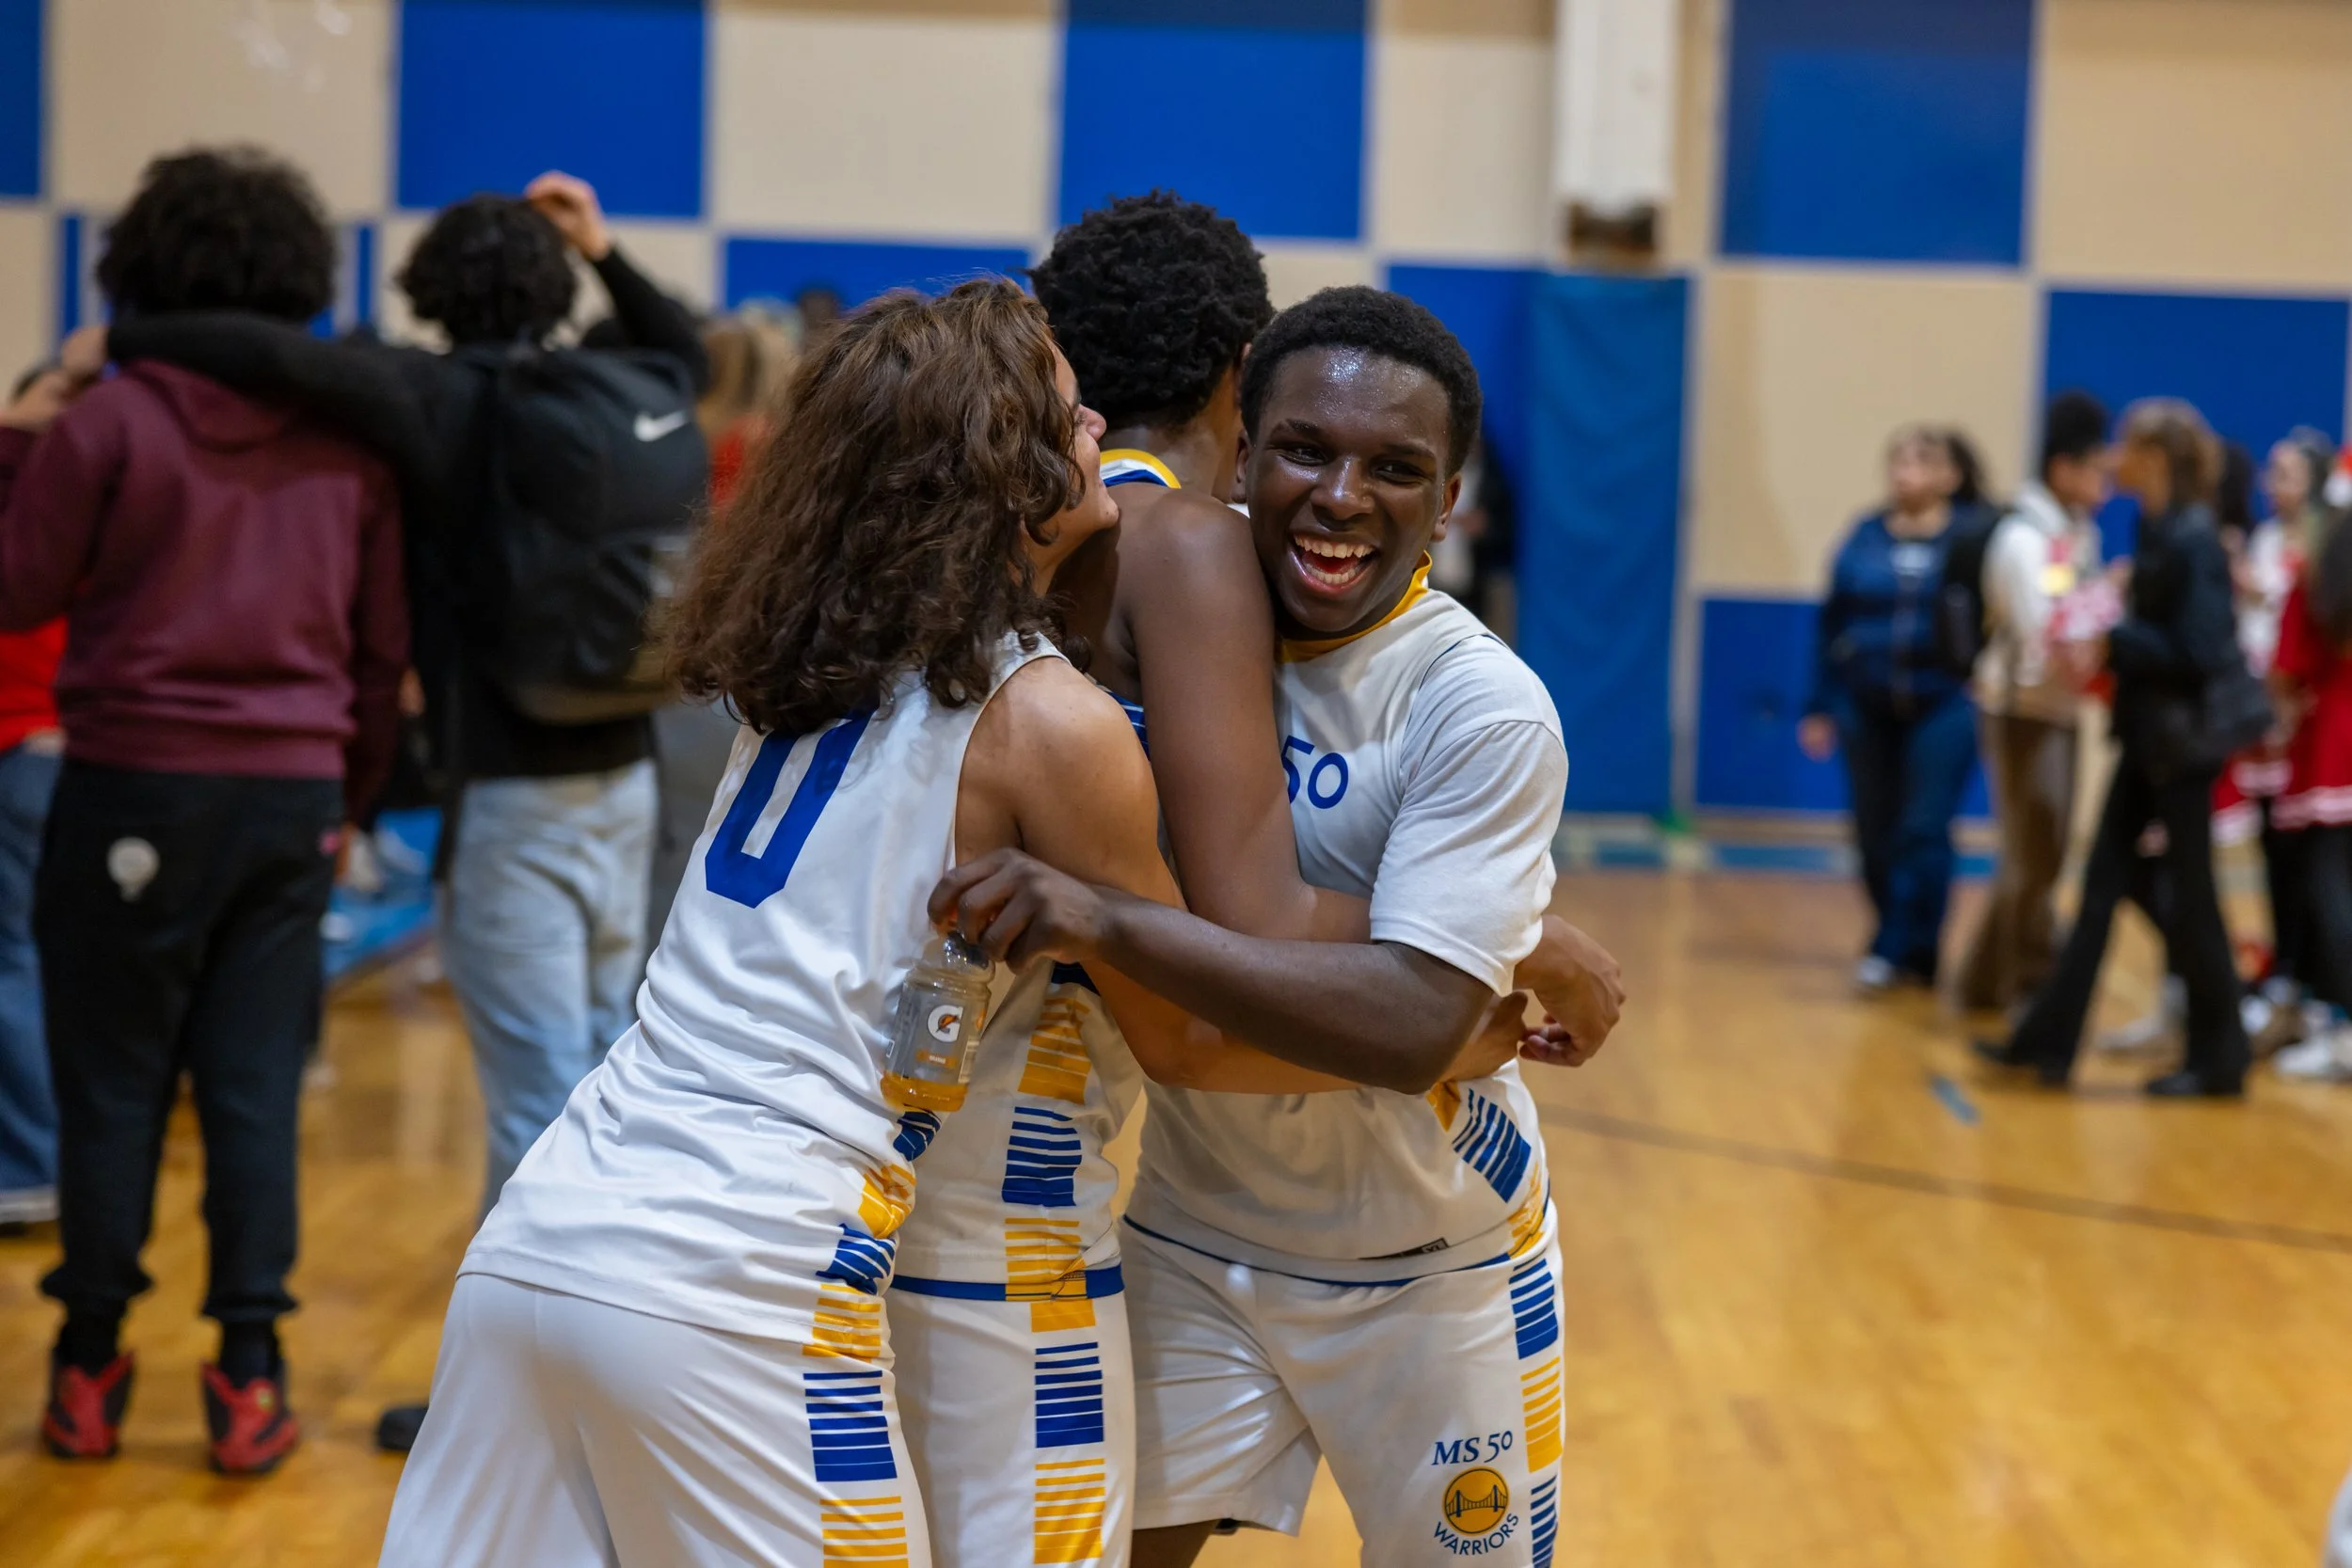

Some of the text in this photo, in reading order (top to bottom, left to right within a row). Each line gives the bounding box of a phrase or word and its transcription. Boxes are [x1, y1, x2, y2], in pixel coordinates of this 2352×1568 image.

[1280, 735, 1348, 809] 50
[928, 1005, 963, 1043] G
[1432, 1431, 1513, 1465] MS 50
[1434, 1513, 1519, 1555] WARRIORS
